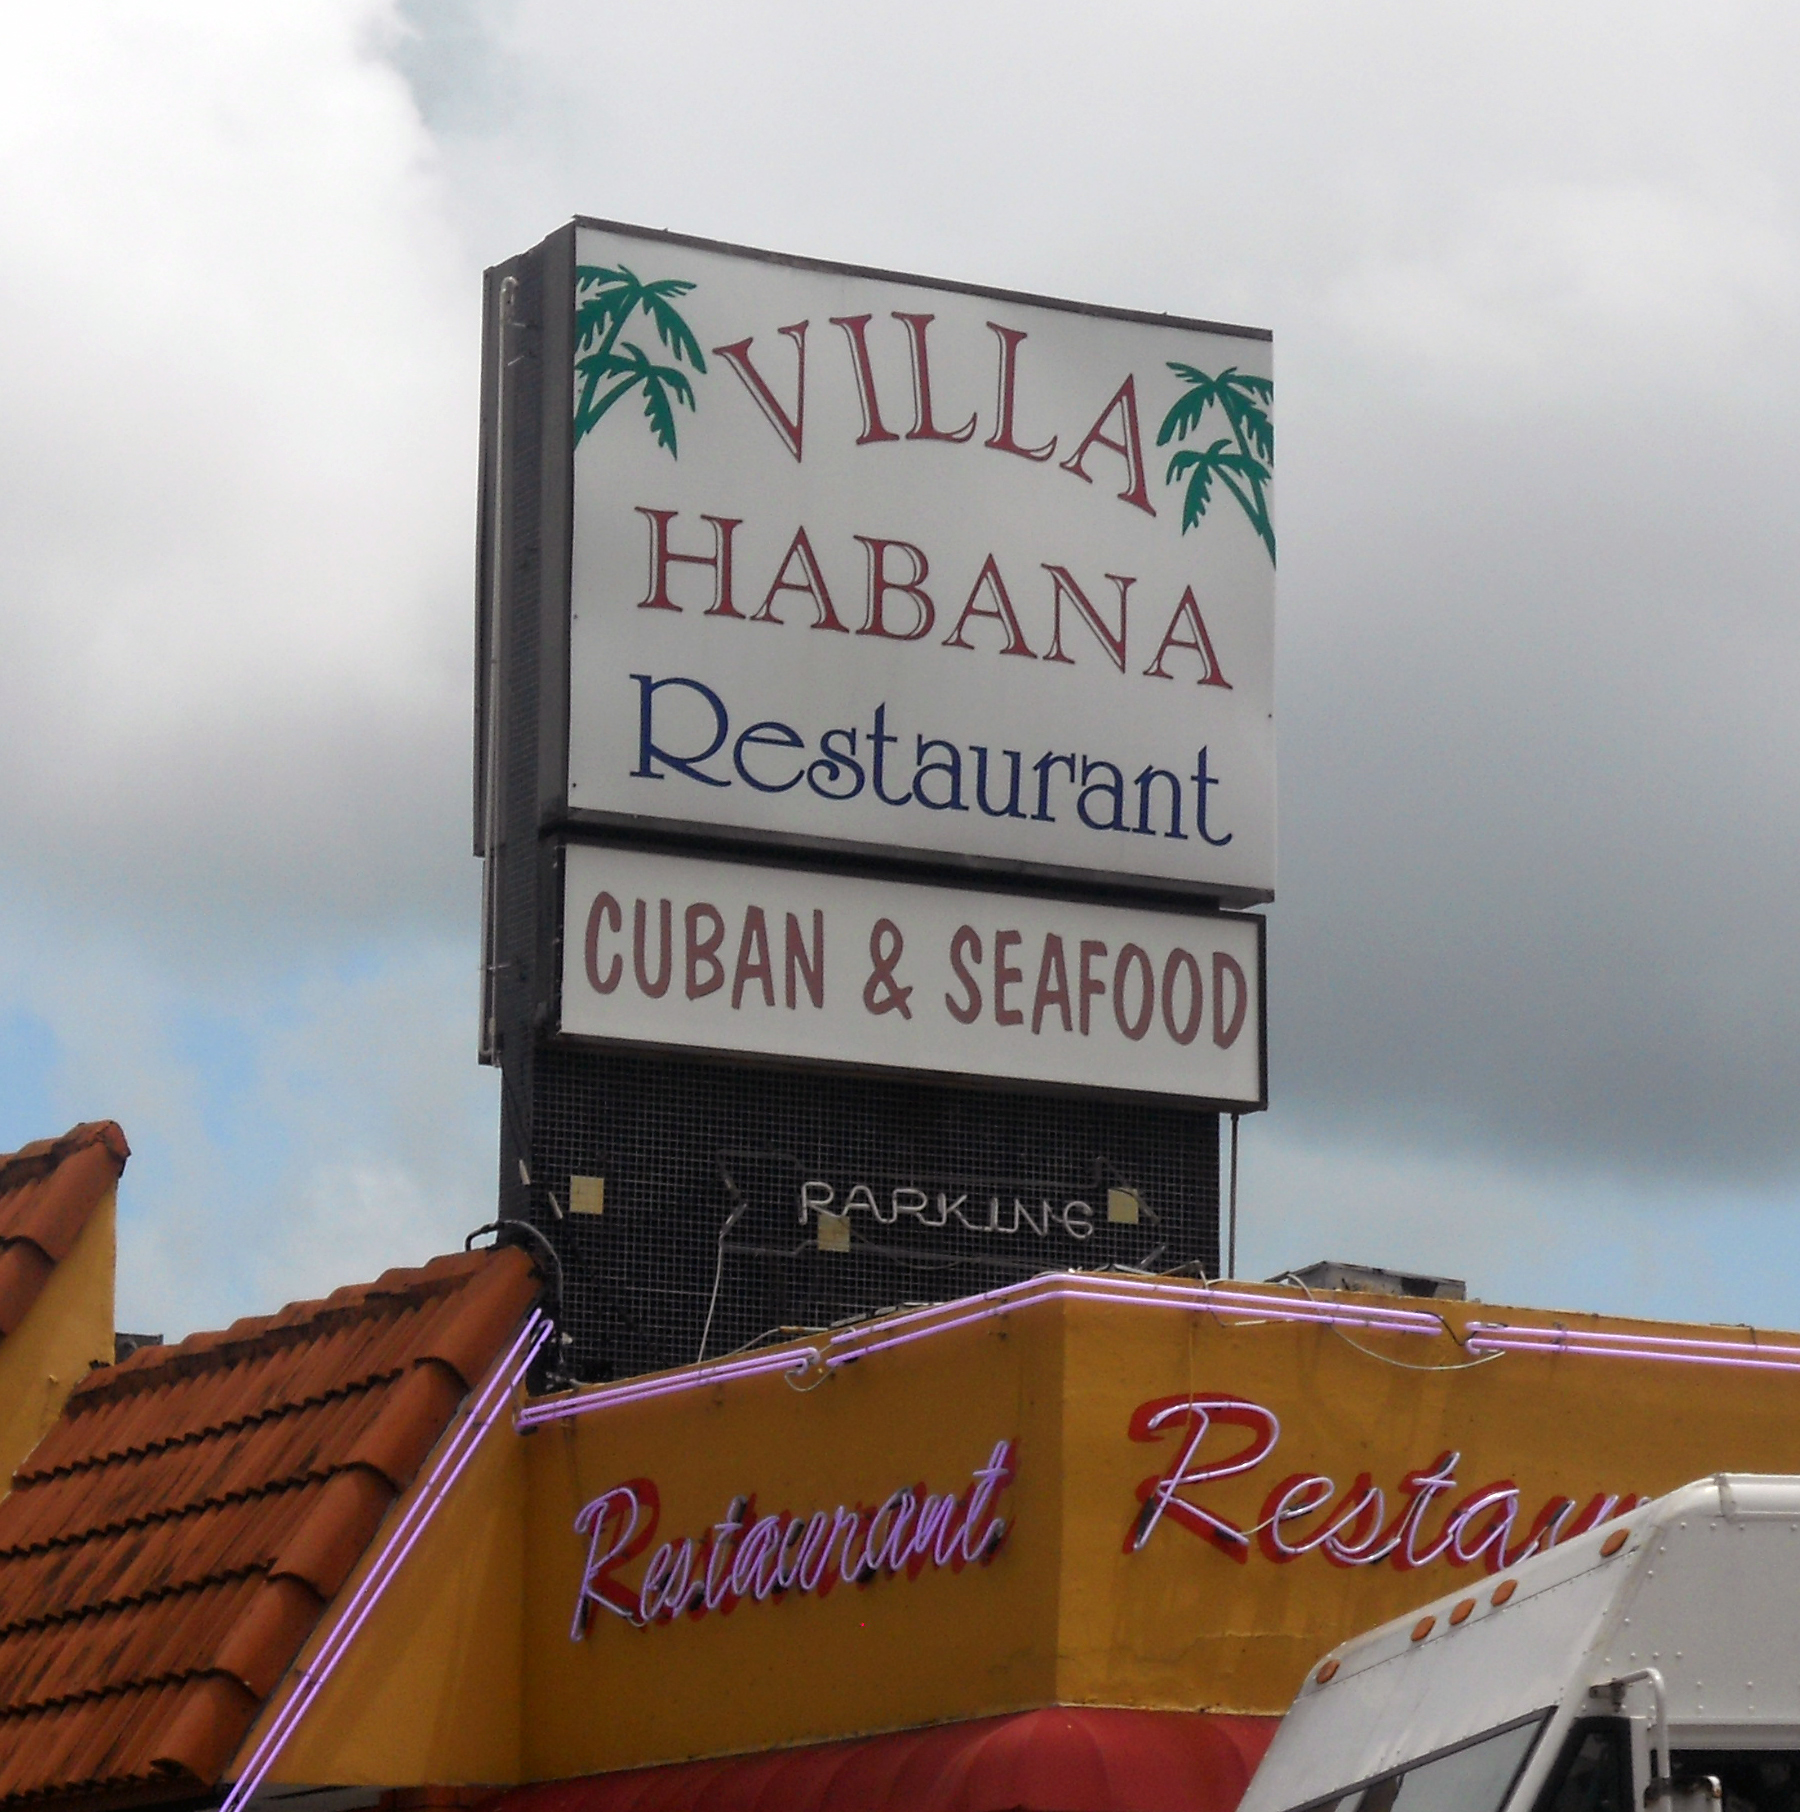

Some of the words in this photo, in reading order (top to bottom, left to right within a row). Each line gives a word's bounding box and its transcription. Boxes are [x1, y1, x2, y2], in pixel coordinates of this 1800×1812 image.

[712, 311, 1157, 517] VILLA
[634, 506, 1233, 690] HABANA
[629, 674, 1233, 846] Restaurant
[585, 891, 825, 1010] CUBAN
[862, 918, 914, 1020] &
[945, 924, 1248, 1049] SEAFOOD
[800, 1181, 1094, 1240] PARKING
[569, 1438, 1020, 1642] Restaurant
[1124, 1392, 1653, 1572] Restau
